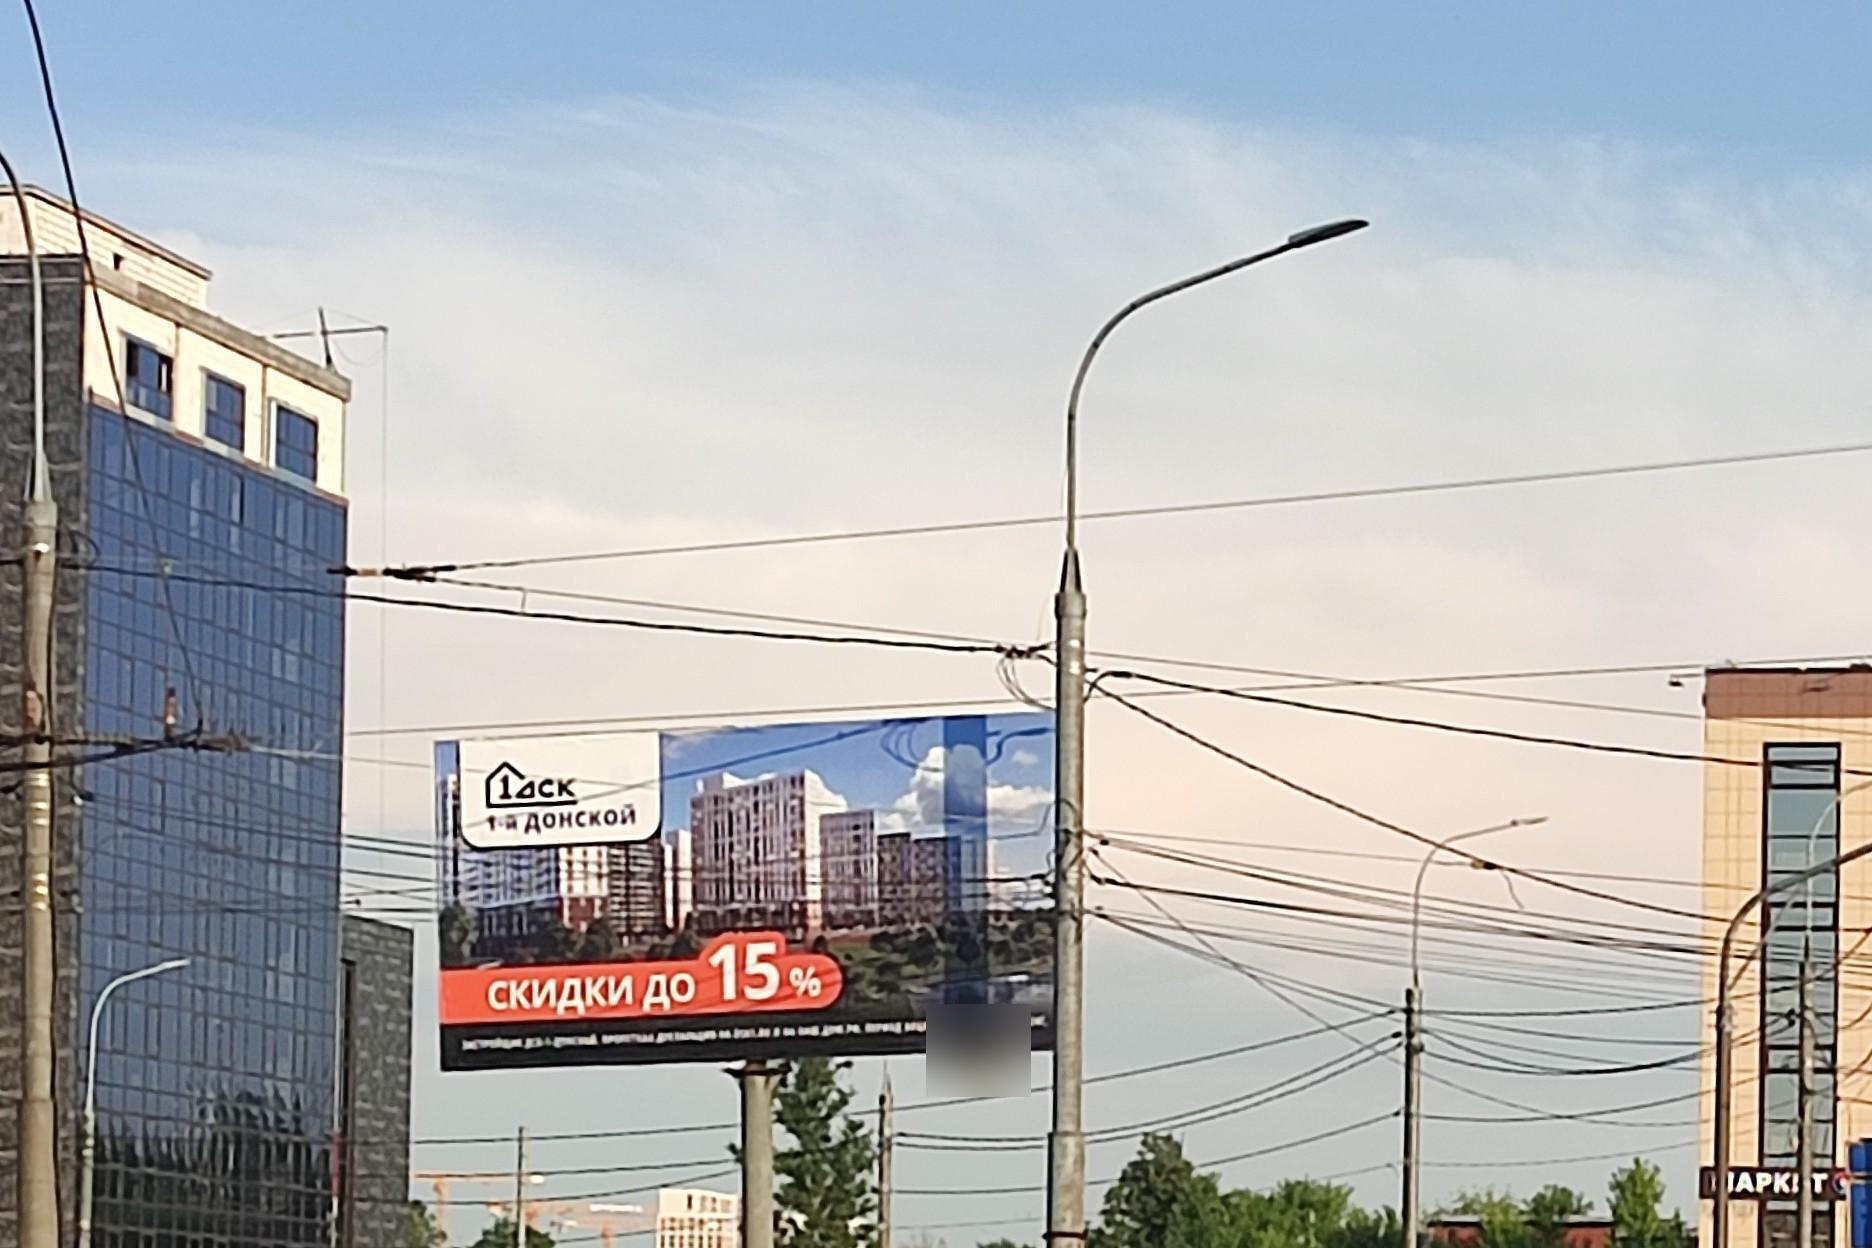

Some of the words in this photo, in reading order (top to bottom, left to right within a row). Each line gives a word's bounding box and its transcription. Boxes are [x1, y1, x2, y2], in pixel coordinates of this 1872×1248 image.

[524, 804, 637, 835] ДОНСКОЙ
[487, 975, 634, 1016] СКИДКИ
[641, 972, 696, 1012] ДО
